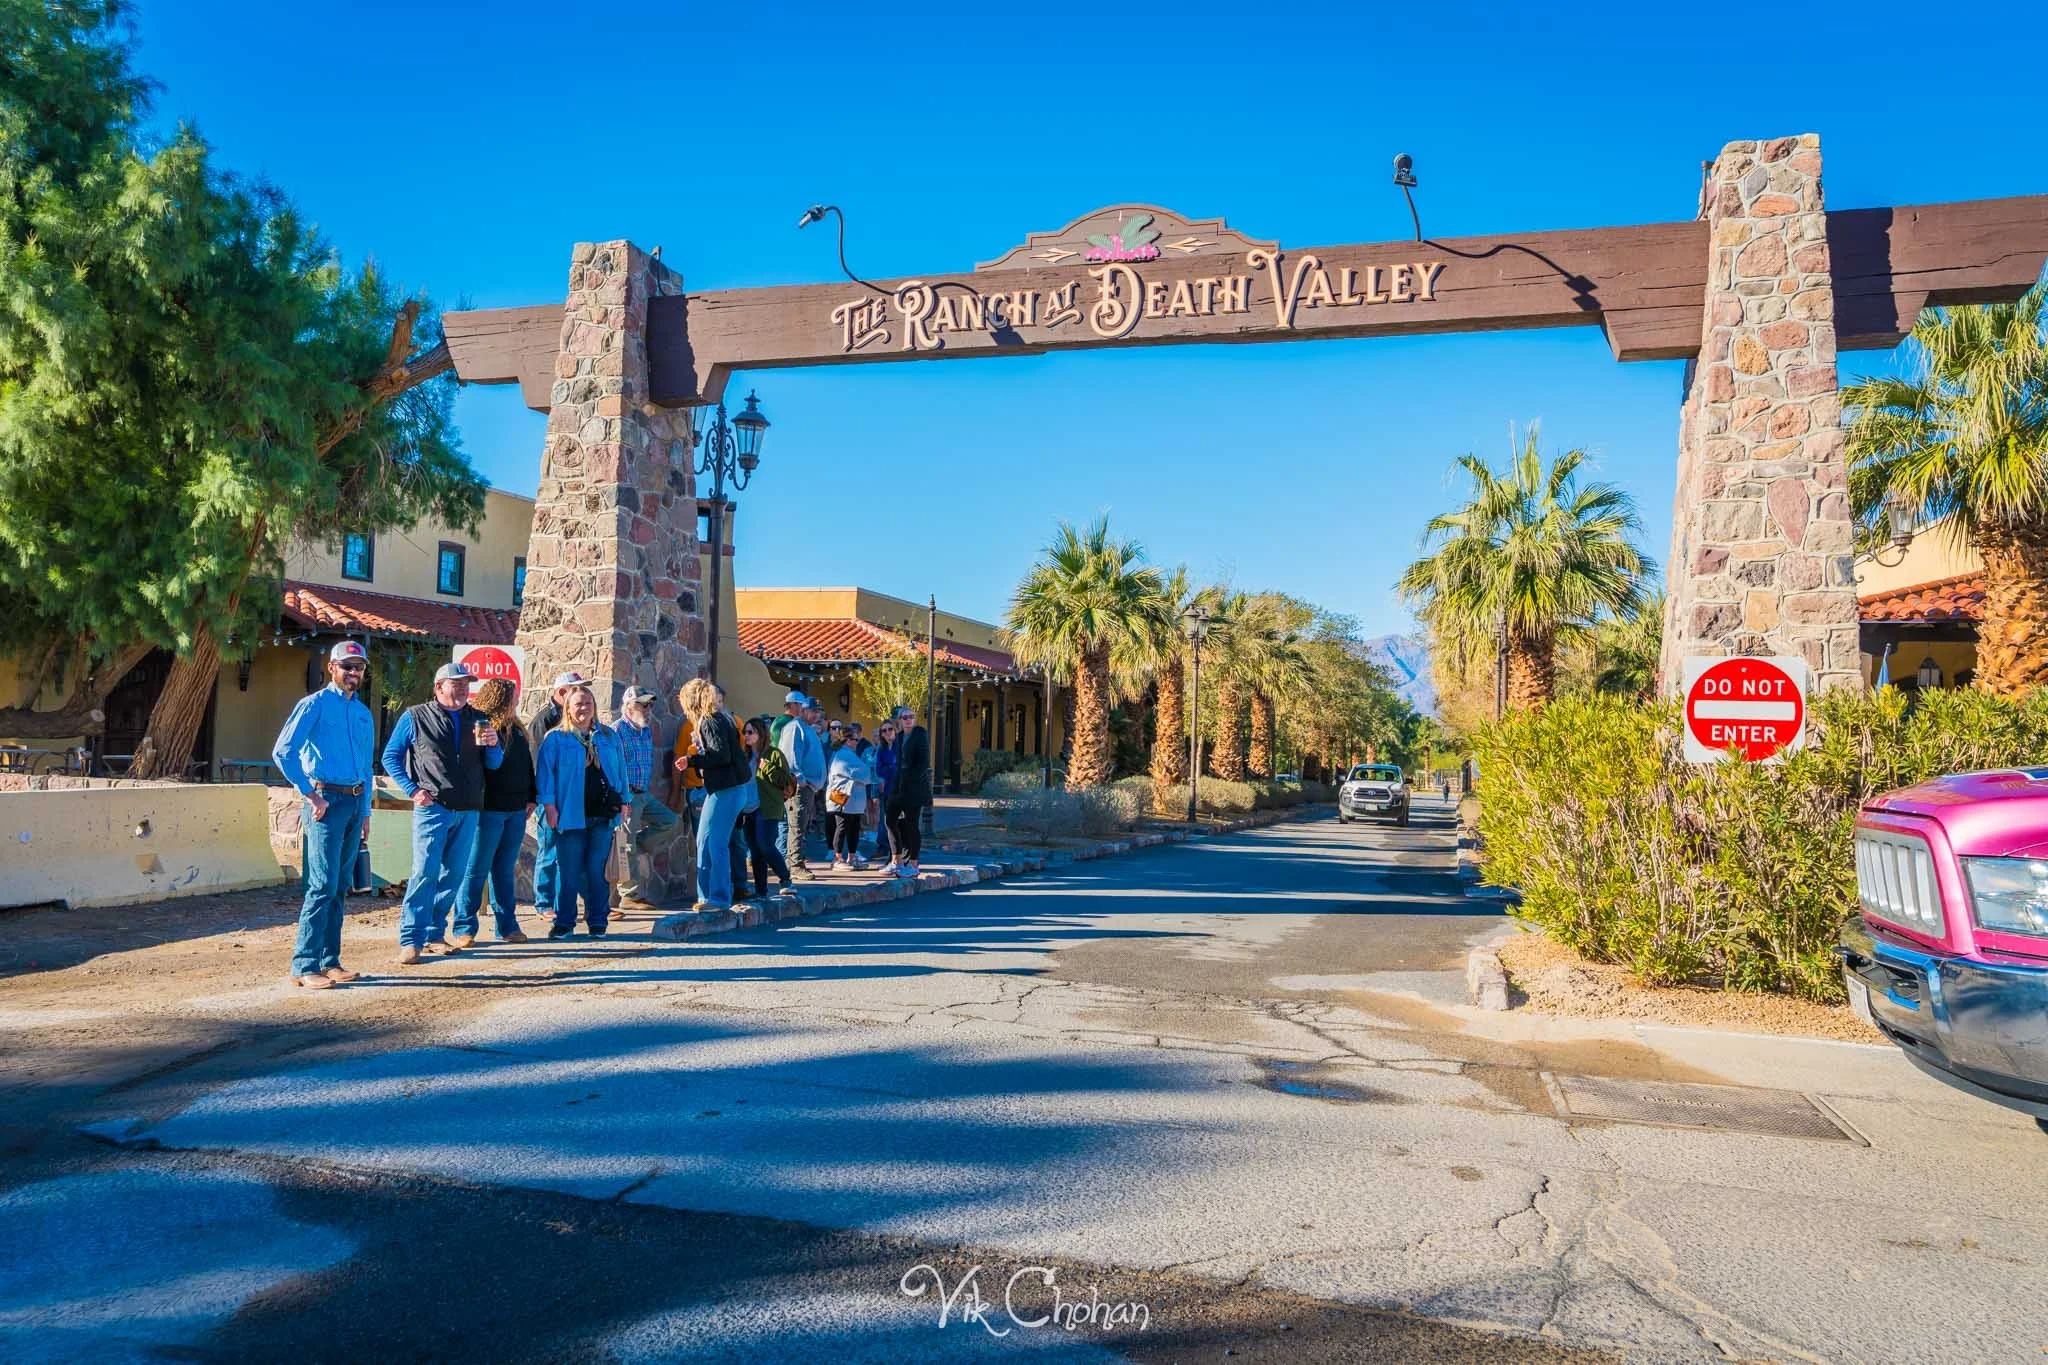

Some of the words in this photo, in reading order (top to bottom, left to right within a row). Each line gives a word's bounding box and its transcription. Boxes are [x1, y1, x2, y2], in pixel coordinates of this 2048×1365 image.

[464, 662, 480, 676] DO
[485, 662, 512, 676] NOT
[1704, 678, 1732, 695] DO
[1742, 679, 1786, 696] NOT
[1711, 724, 1777, 743] ENTER
